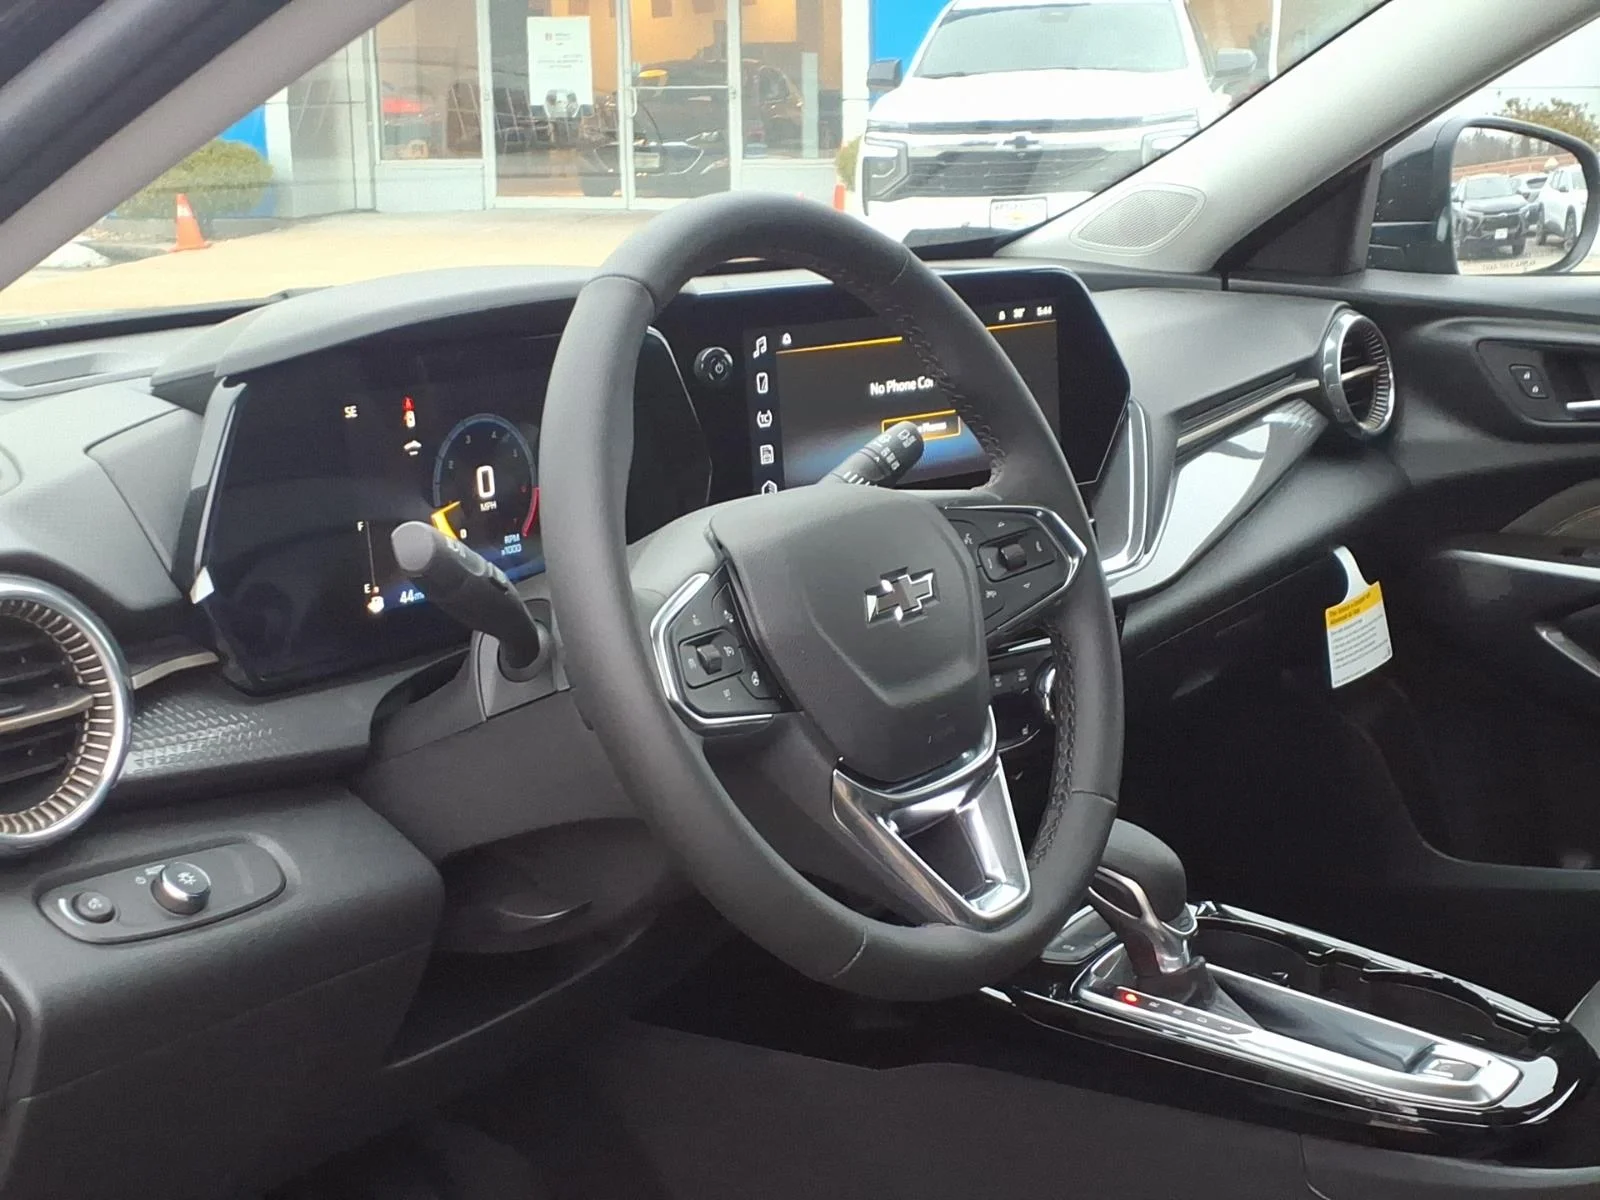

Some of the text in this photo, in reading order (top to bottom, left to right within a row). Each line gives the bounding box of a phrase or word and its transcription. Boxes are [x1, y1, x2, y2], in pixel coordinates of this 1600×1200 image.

[870, 382, 885, 396] No
[886, 379, 917, 393] Phone
[344, 405, 358, 418] SE
[476, 465, 496, 498] 0
[480, 501, 497, 512] MPH
[357, 521, 364, 532] F
[504, 533, 520, 544] RPM
[364, 583, 371, 594] E
